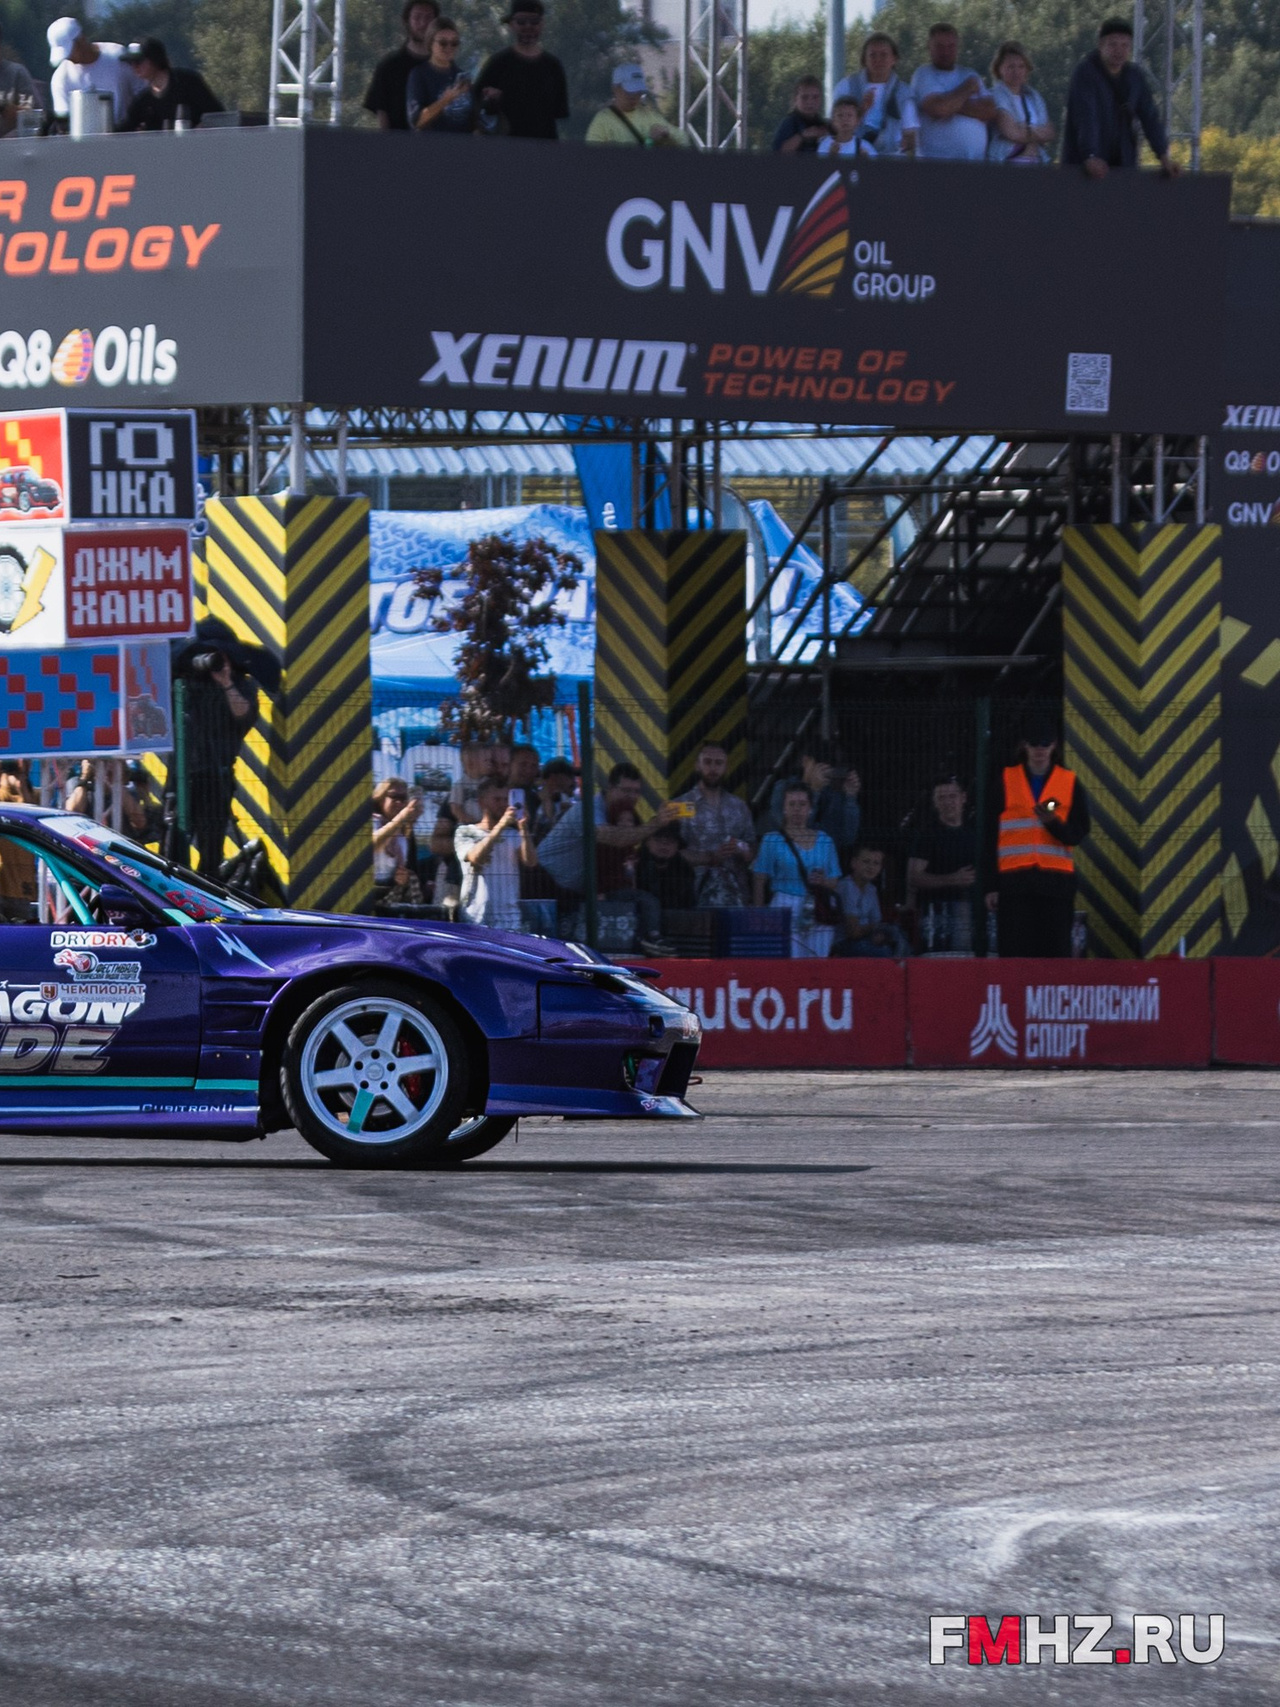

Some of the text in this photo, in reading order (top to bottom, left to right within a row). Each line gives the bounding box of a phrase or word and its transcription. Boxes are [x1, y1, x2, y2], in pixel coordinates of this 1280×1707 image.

[51, 174, 136, 222] OF
[606, 196, 794, 295] GNV
[853, 239, 893, 267] OIL
[852, 271, 936, 302] GROUP
[419, 330, 688, 397] XENUM
[708, 343, 908, 374] POWER OF
[702, 372, 957, 406] TECHNOLOGY
[89, 421, 175, 467] ГО
[91, 470, 176, 515] НКА
[1228, 502, 1273, 524] GNV
[72, 546, 183, 588] ДЖИМ
[72, 588, 185, 627] ХАНА
[52, 933, 129, 946] DRYDRY
[60, 984, 145, 994] ЧЕМПИОНАТ
[1025, 977, 1160, 1021] МОСКОВСКИЙ
[1025, 1022, 1089, 1058] СПОРТ
